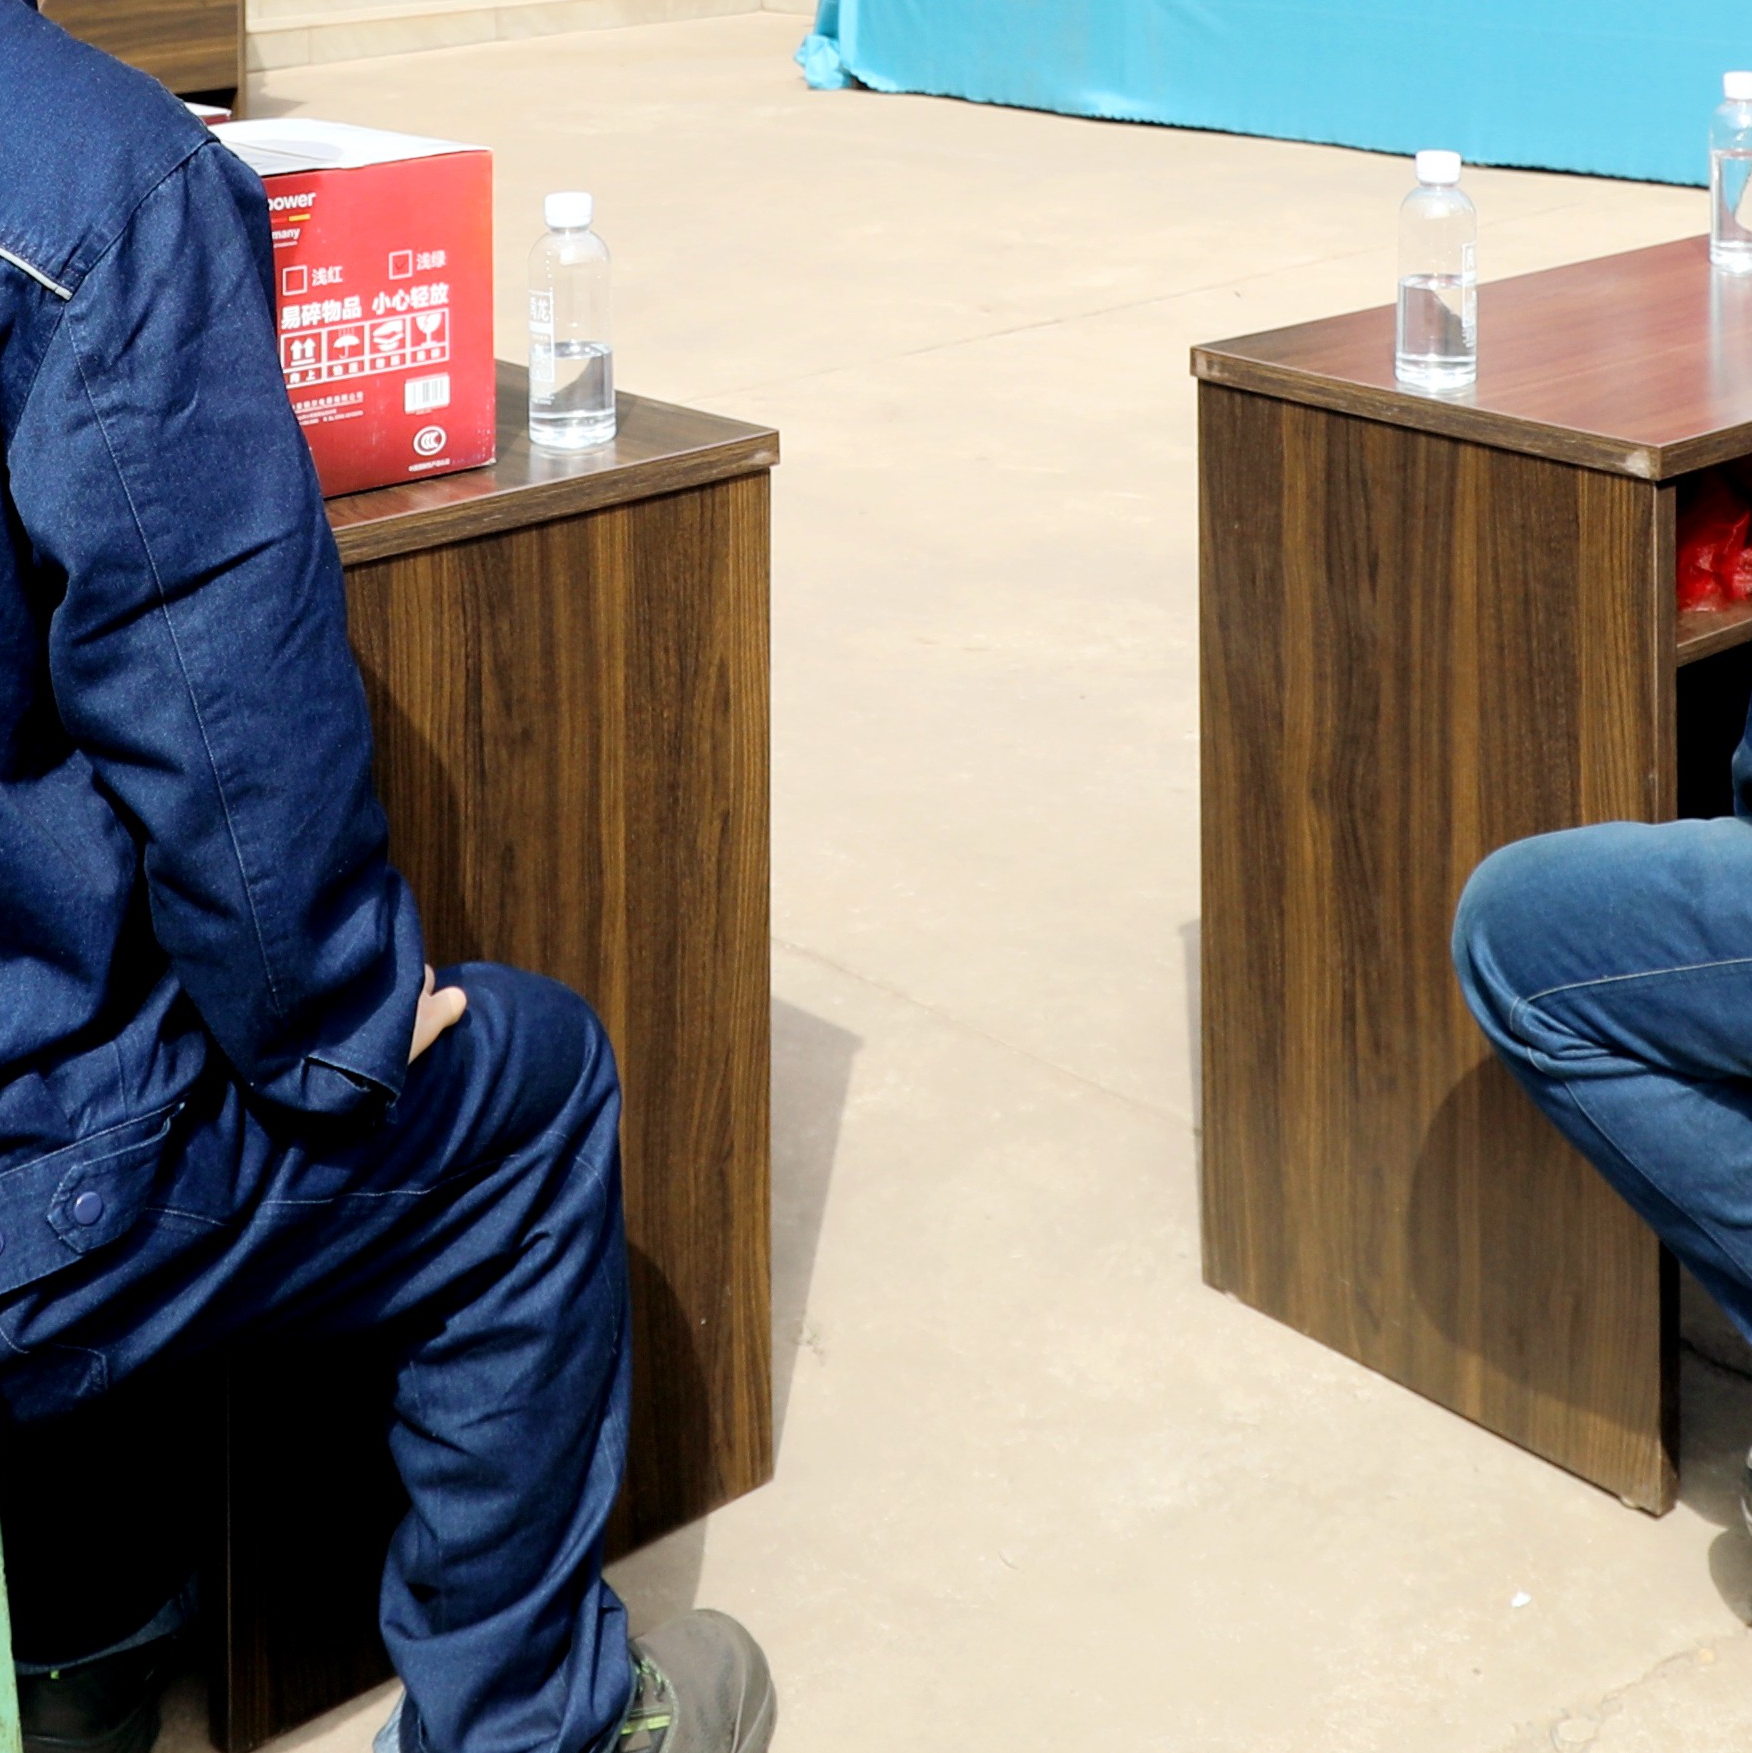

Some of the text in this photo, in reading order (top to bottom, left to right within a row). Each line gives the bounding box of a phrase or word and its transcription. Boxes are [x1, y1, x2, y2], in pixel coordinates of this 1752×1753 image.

[311, 250, 446, 286] 浅红 浅绿
[281, 282, 450, 330] 易碎物品 小心轻放
